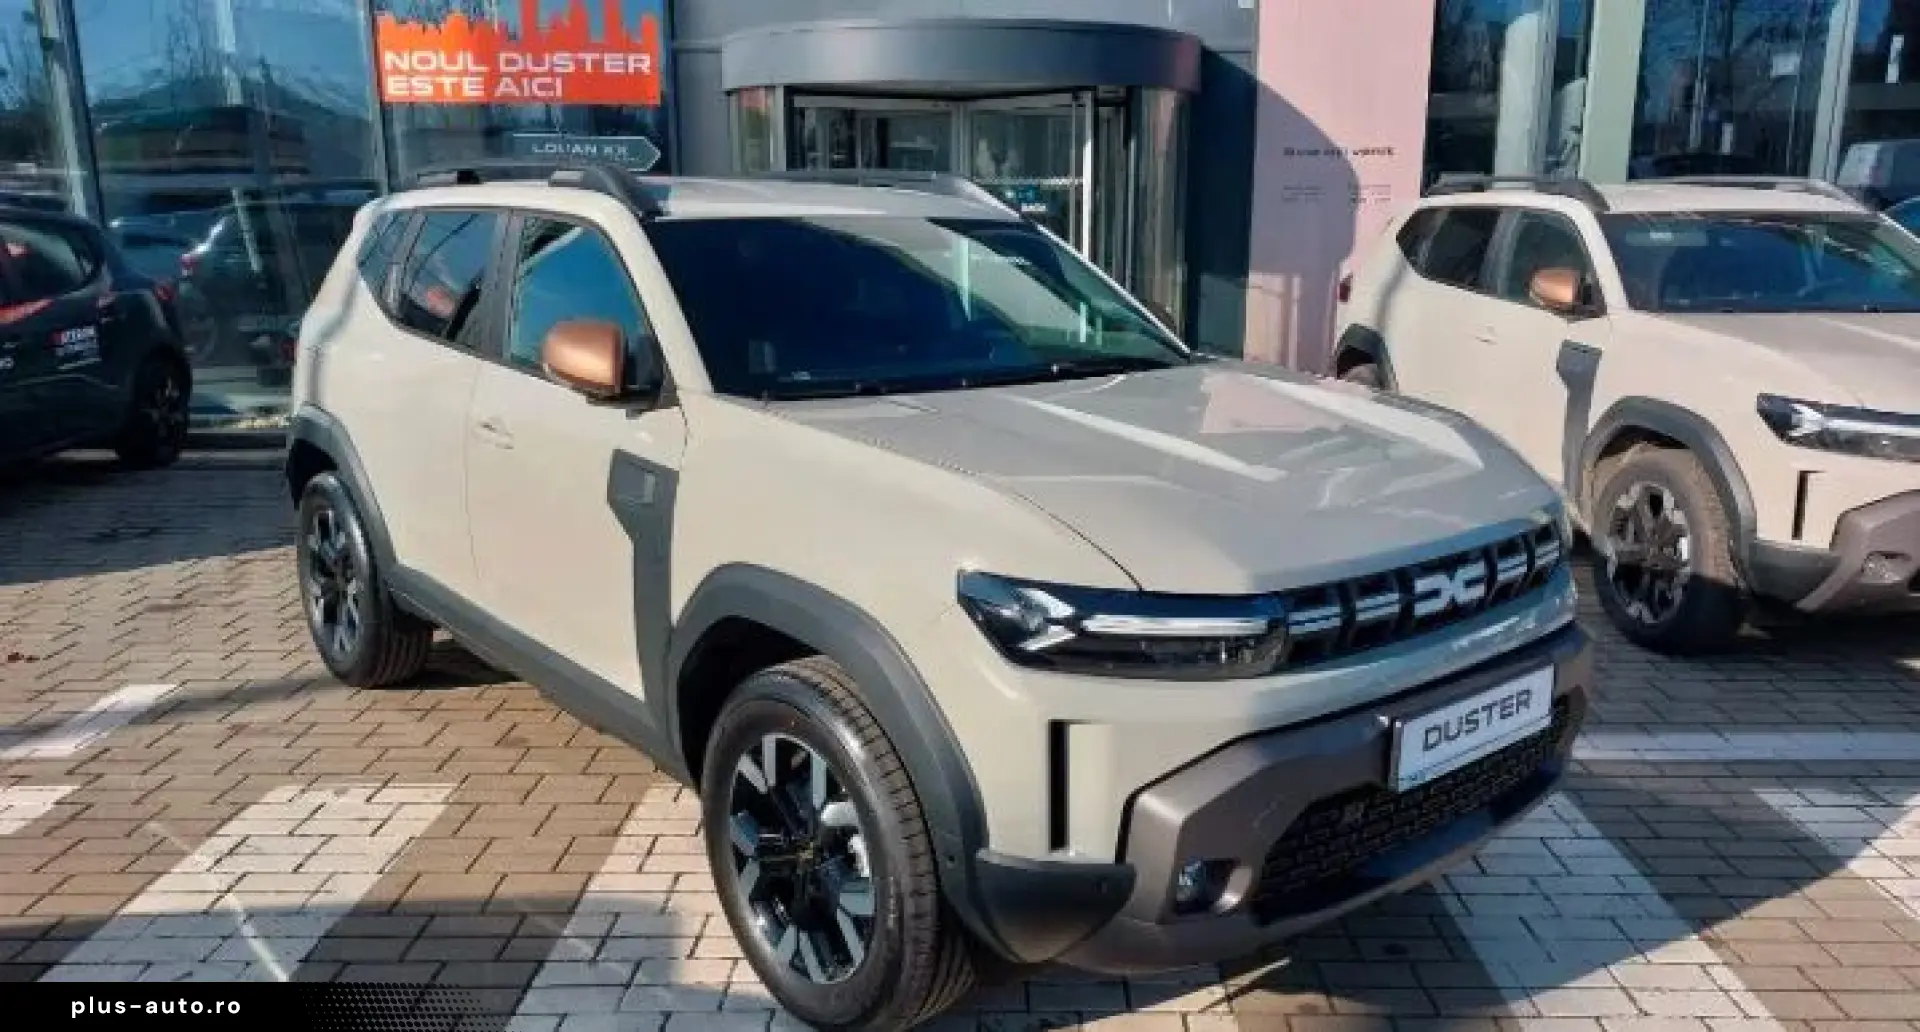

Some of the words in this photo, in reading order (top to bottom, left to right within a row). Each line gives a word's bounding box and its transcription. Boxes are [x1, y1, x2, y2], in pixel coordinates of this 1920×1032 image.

[384, 50, 488, 72] NOUL
[500, 51, 651, 76] DUSTER
[387, 75, 485, 97] ESTE
[494, 76, 563, 98] AICI
[1422, 688, 1533, 752] DUSTER
